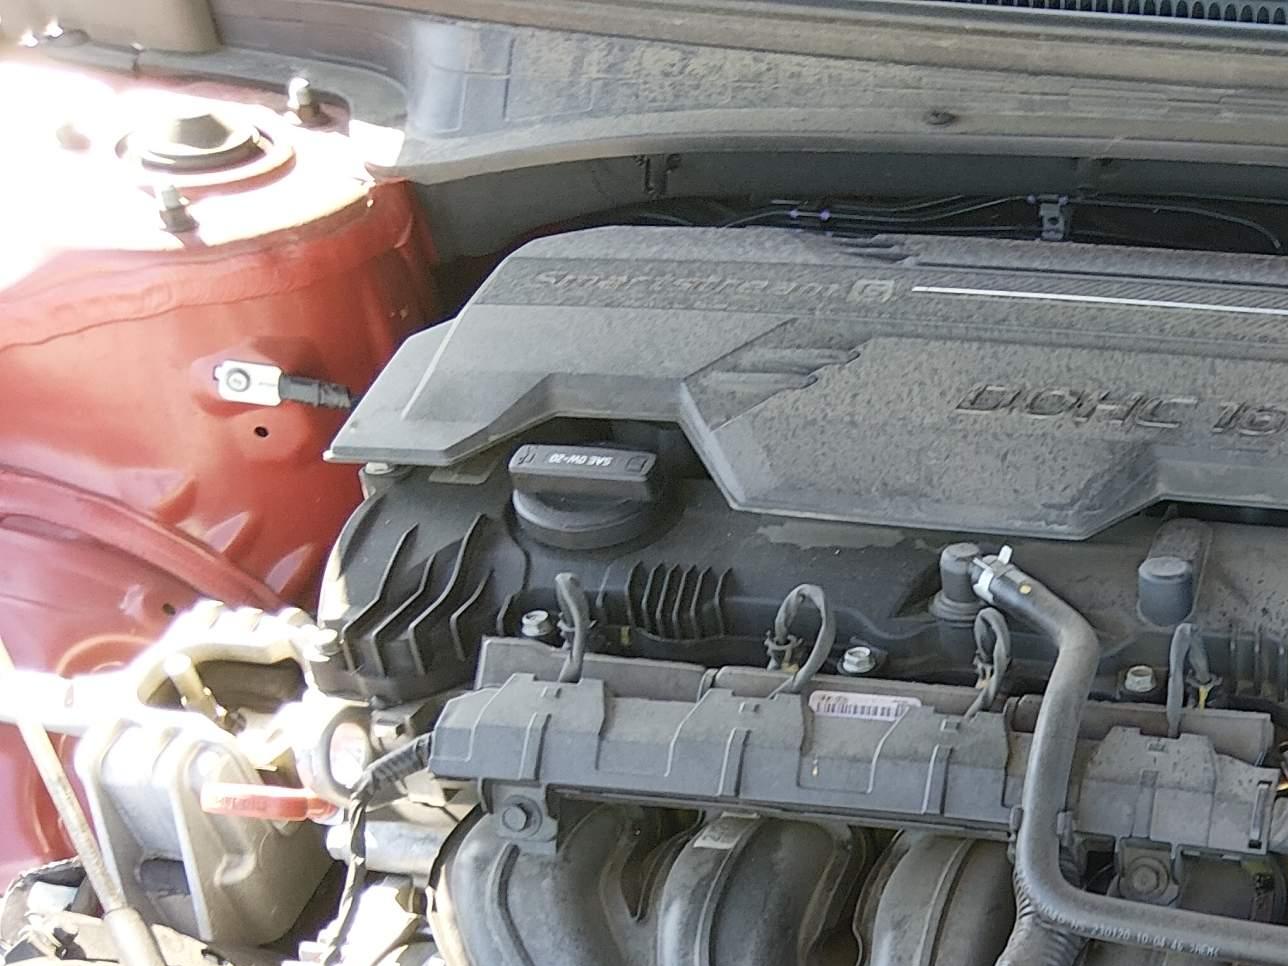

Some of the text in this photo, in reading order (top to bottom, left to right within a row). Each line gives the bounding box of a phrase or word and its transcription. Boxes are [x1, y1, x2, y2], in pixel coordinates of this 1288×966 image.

[956, 384, 1198, 428] DOHC
[549, 453, 613, 466] SAE 0W-20
